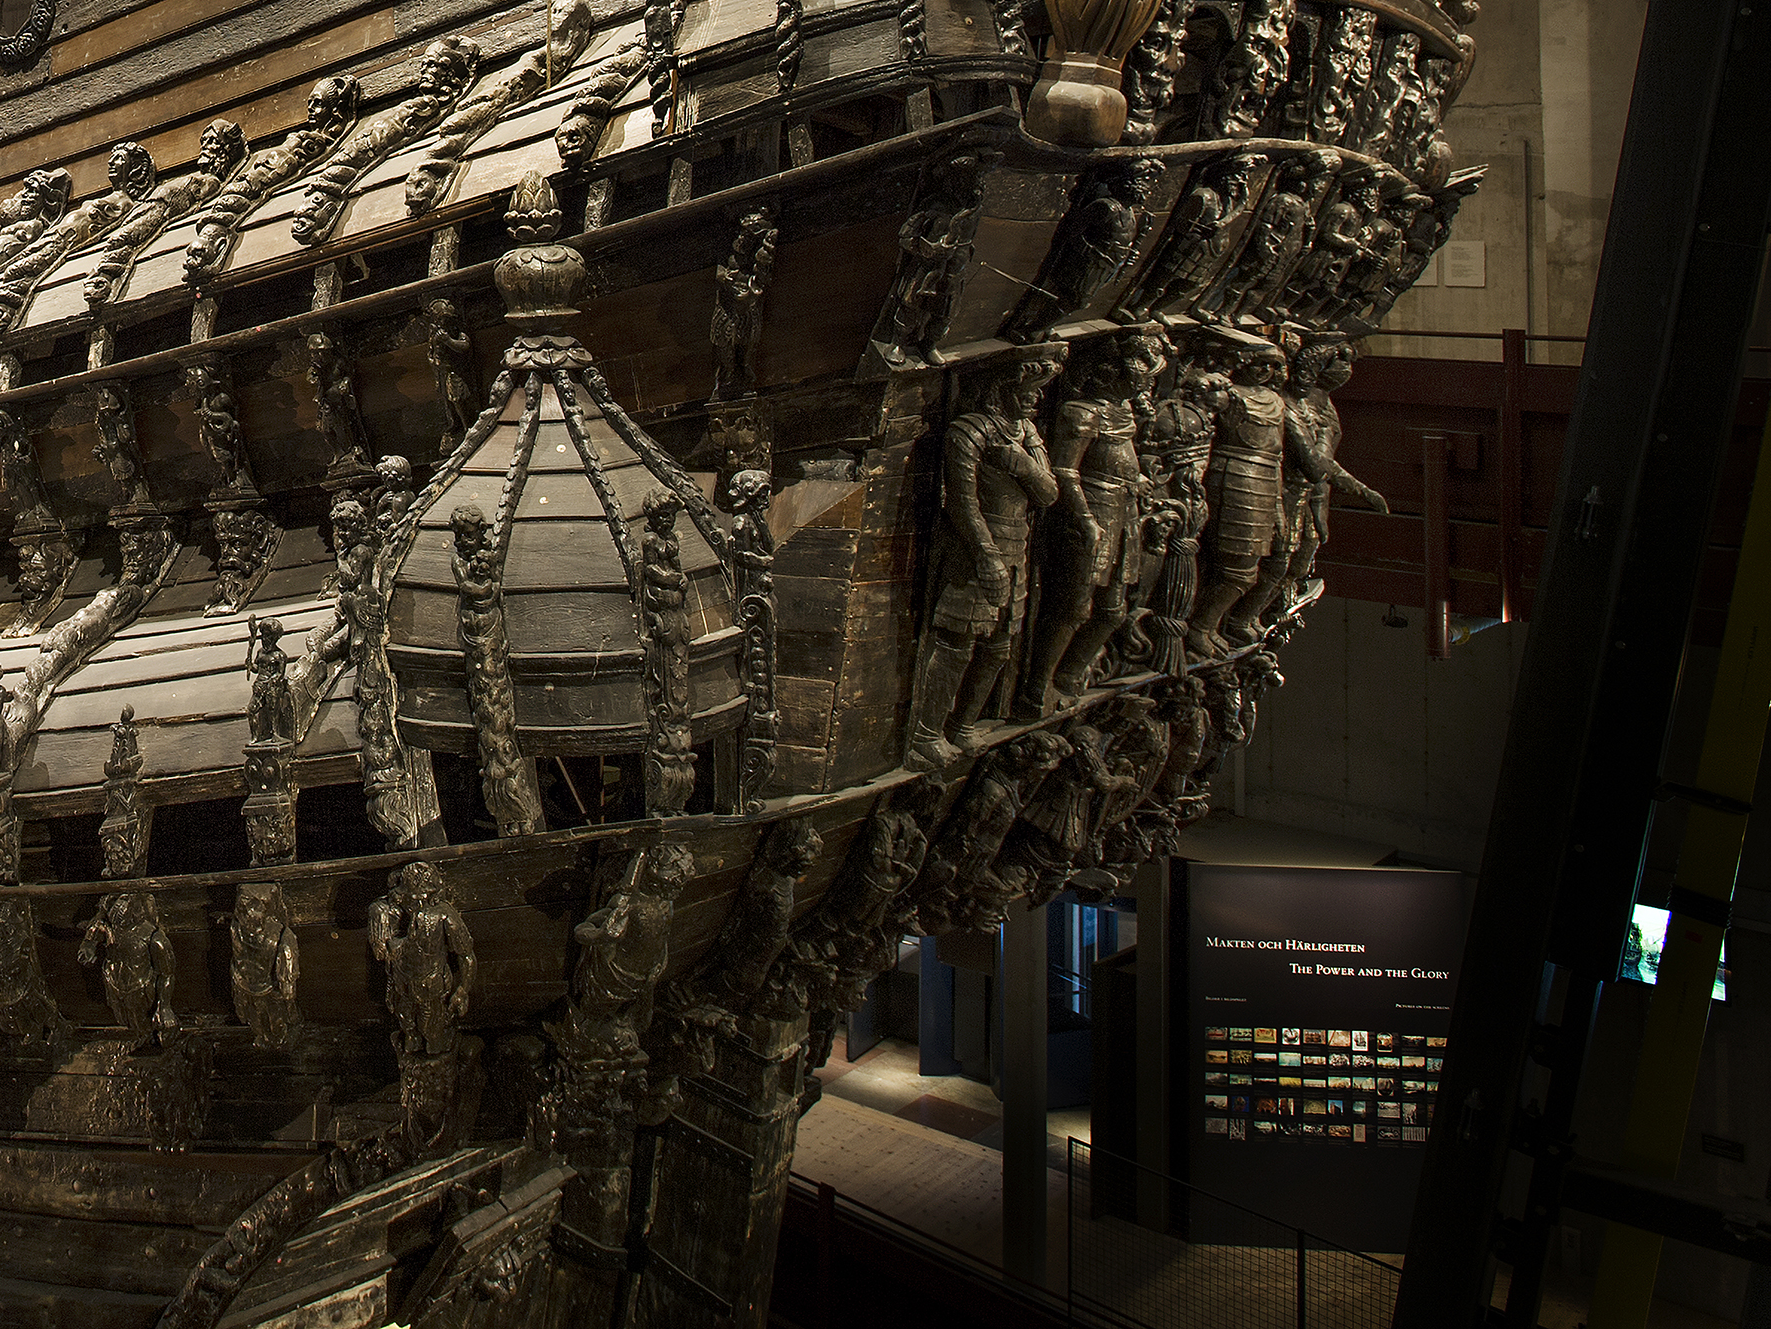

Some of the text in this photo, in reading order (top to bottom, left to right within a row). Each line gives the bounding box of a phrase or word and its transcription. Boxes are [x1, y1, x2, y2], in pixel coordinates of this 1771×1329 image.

[1205, 936, 1255, 949] MAKTEN
[1288, 962, 1450, 980] THE POWER AND THE GLORY
